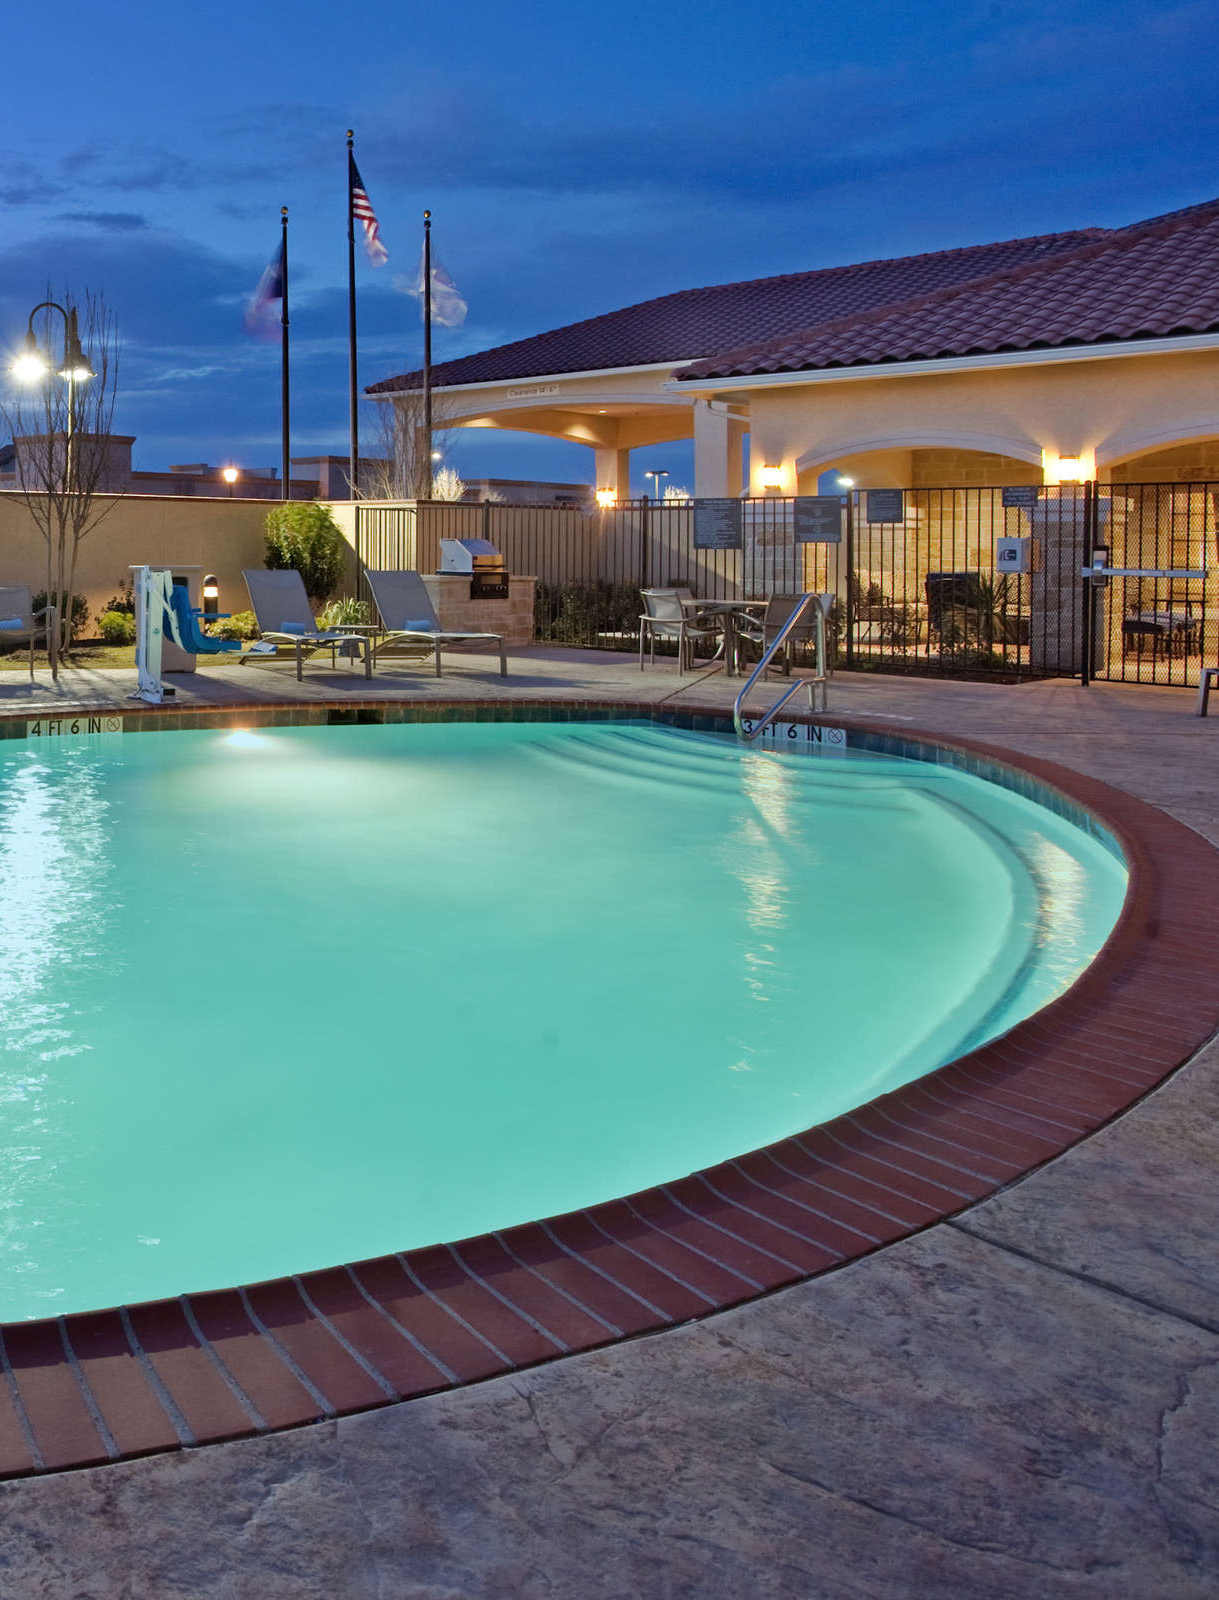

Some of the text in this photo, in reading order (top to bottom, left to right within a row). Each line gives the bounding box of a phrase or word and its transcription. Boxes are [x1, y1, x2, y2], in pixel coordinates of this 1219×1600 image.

[31, 717, 101, 737] 4 FT 6 IN
[743, 719, 752, 735] 3
[787, 725, 797, 739] 6
[807, 725, 822, 743] IN
